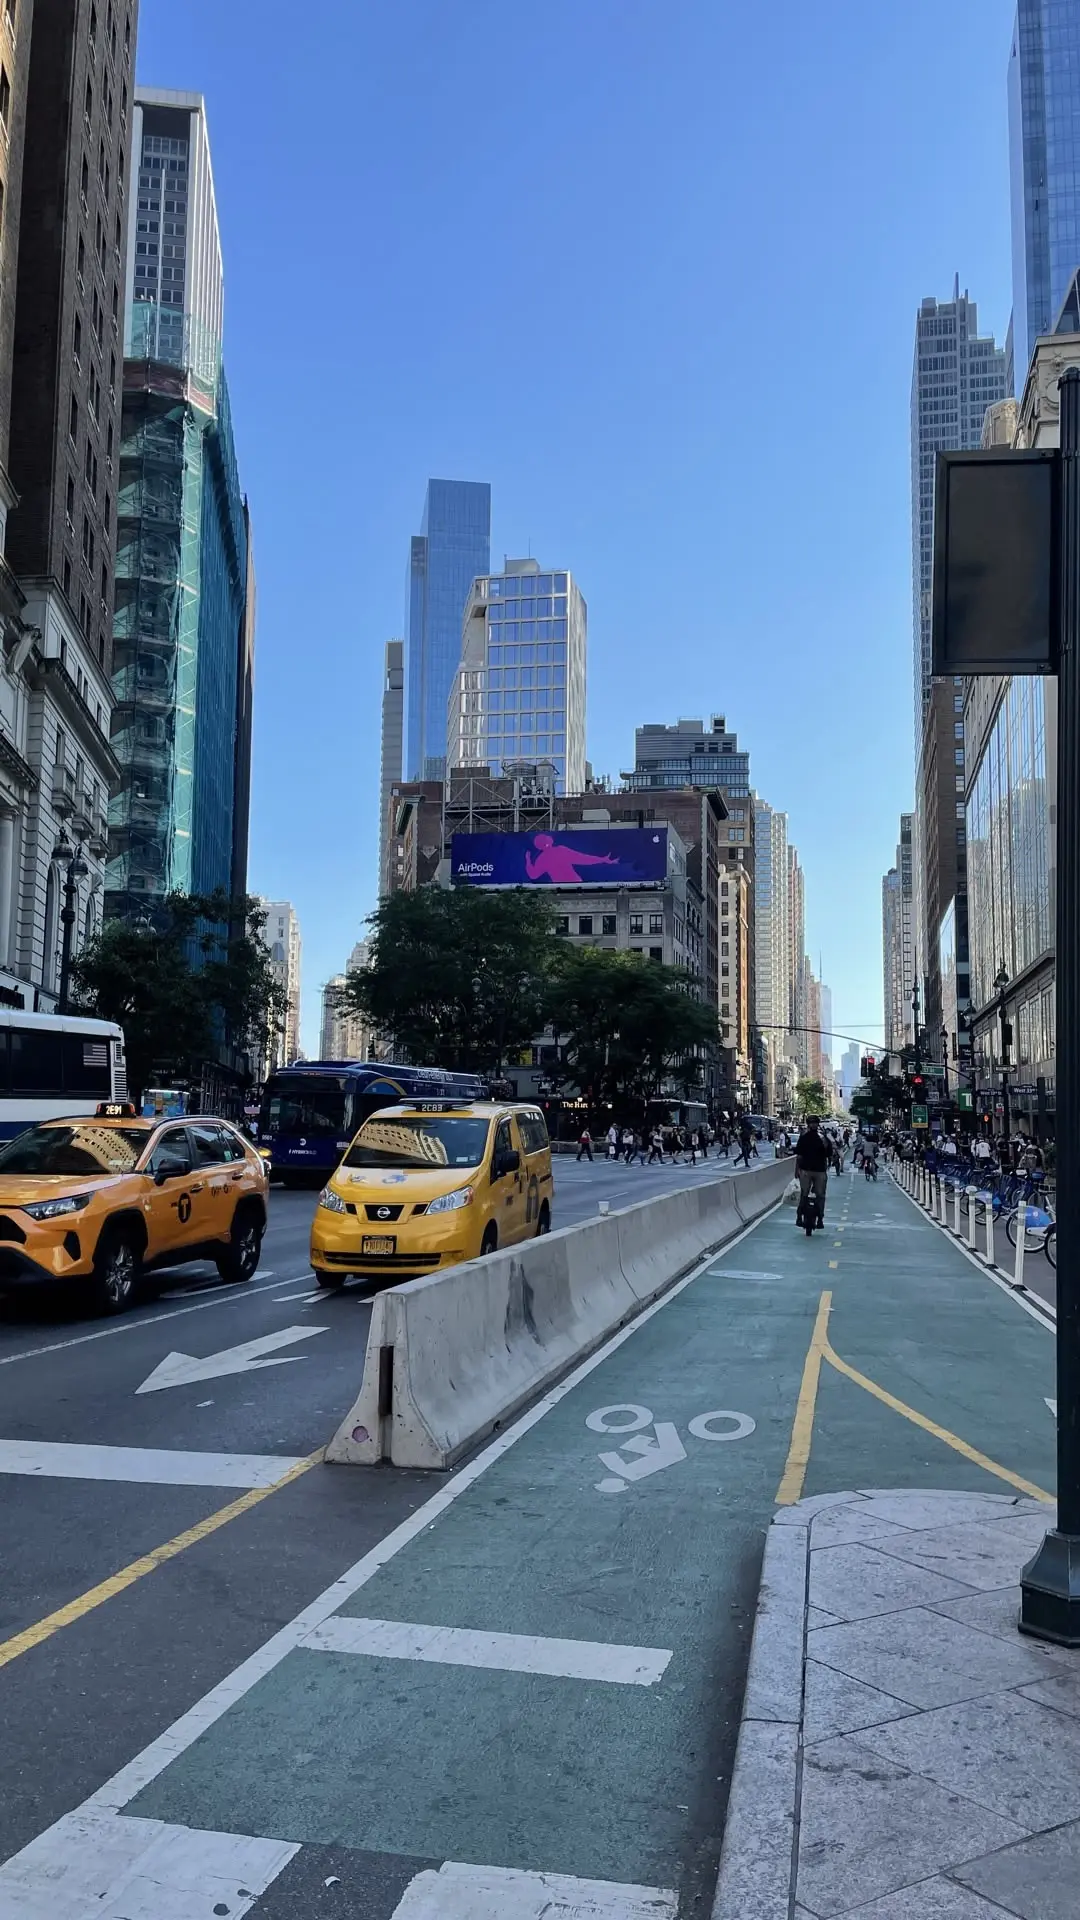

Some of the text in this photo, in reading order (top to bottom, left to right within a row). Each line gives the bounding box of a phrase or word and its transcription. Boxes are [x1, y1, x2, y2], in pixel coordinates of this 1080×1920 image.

[458, 863, 494, 871] AirPods
[562, 1101, 574, 1109] The
[105, 1105, 122, 1115] 2E91
